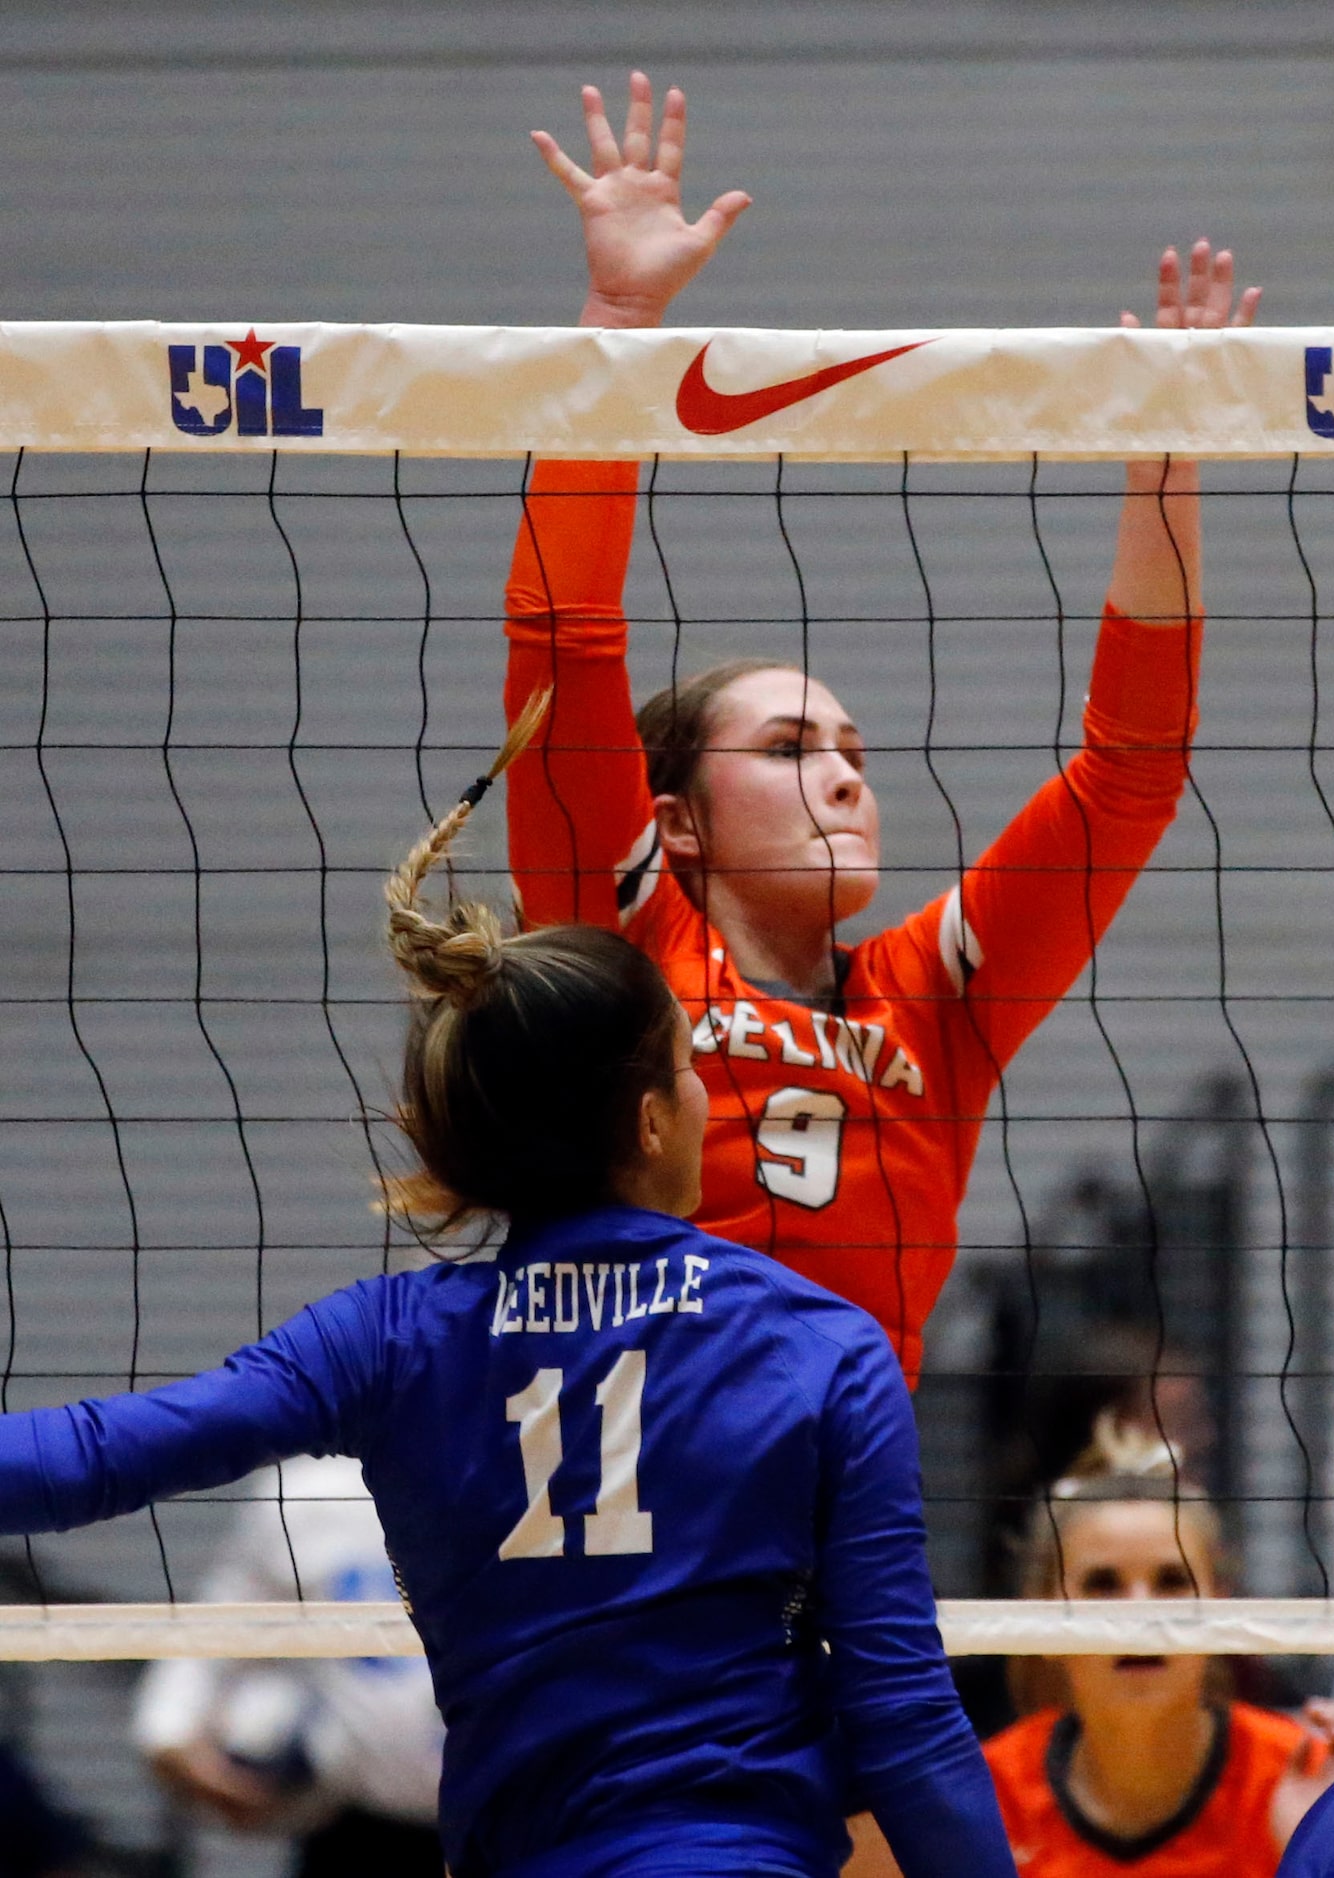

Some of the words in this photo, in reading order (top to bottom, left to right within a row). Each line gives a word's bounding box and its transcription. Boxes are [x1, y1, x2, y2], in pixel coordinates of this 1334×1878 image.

[167, 327, 324, 437] UIL
[755, 1085, 849, 1212] 9
[497, 1349, 654, 1562] 11
